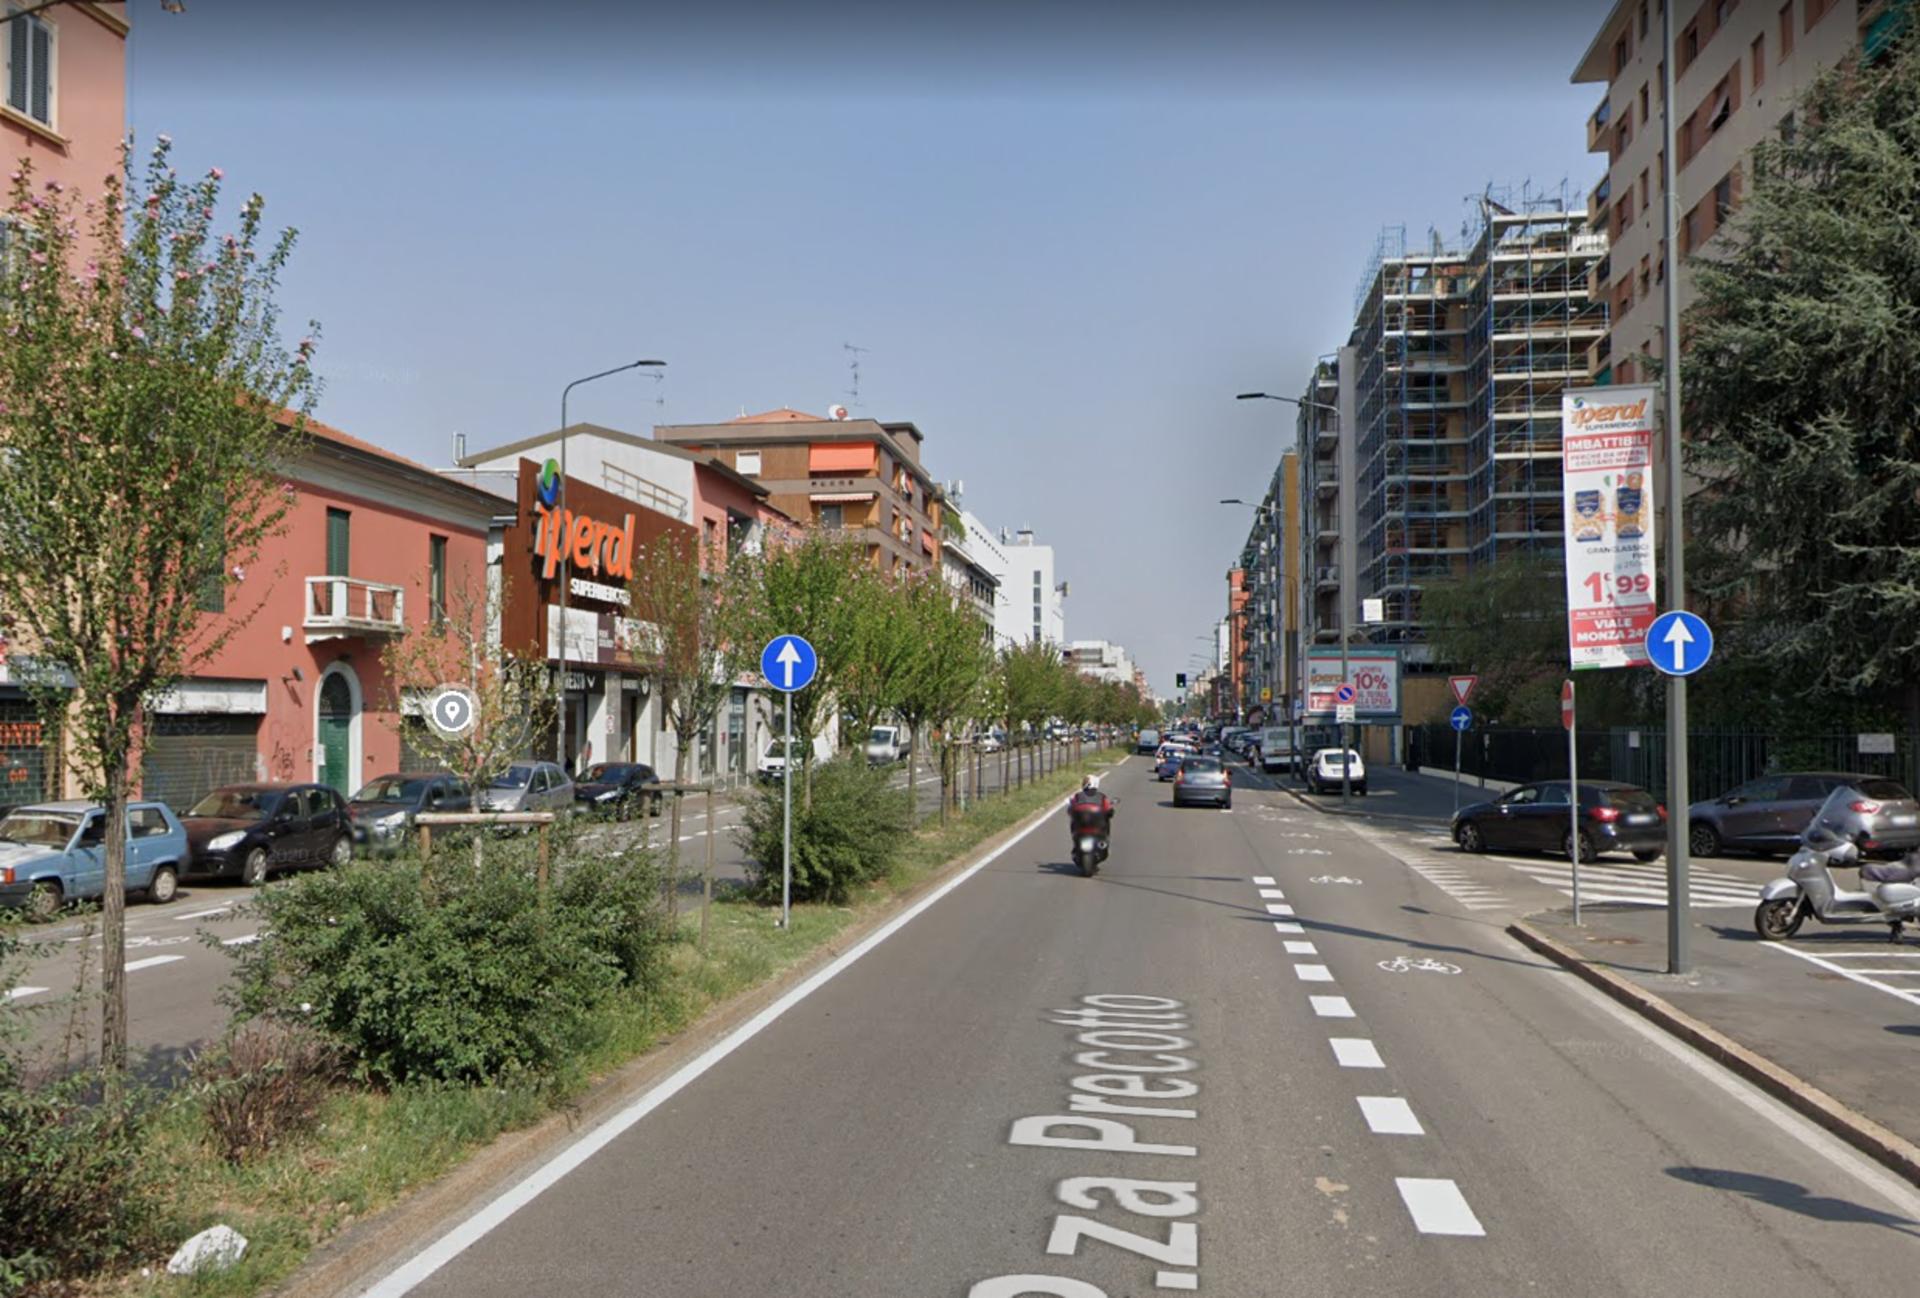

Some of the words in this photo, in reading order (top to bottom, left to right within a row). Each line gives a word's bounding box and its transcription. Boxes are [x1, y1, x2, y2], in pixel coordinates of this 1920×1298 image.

[1570, 398, 1647, 428] iperal
[1567, 434, 1649, 449] IMBATTIBILI
[534, 501, 636, 581] iperal
[1593, 617, 1633, 629] VIALE
[1576, 630, 1625, 642] MONZA
[1628, 628, 1648, 638] 24
[1352, 673, 1389, 690] 10%
[1007, 993, 1198, 1156] Precotto
